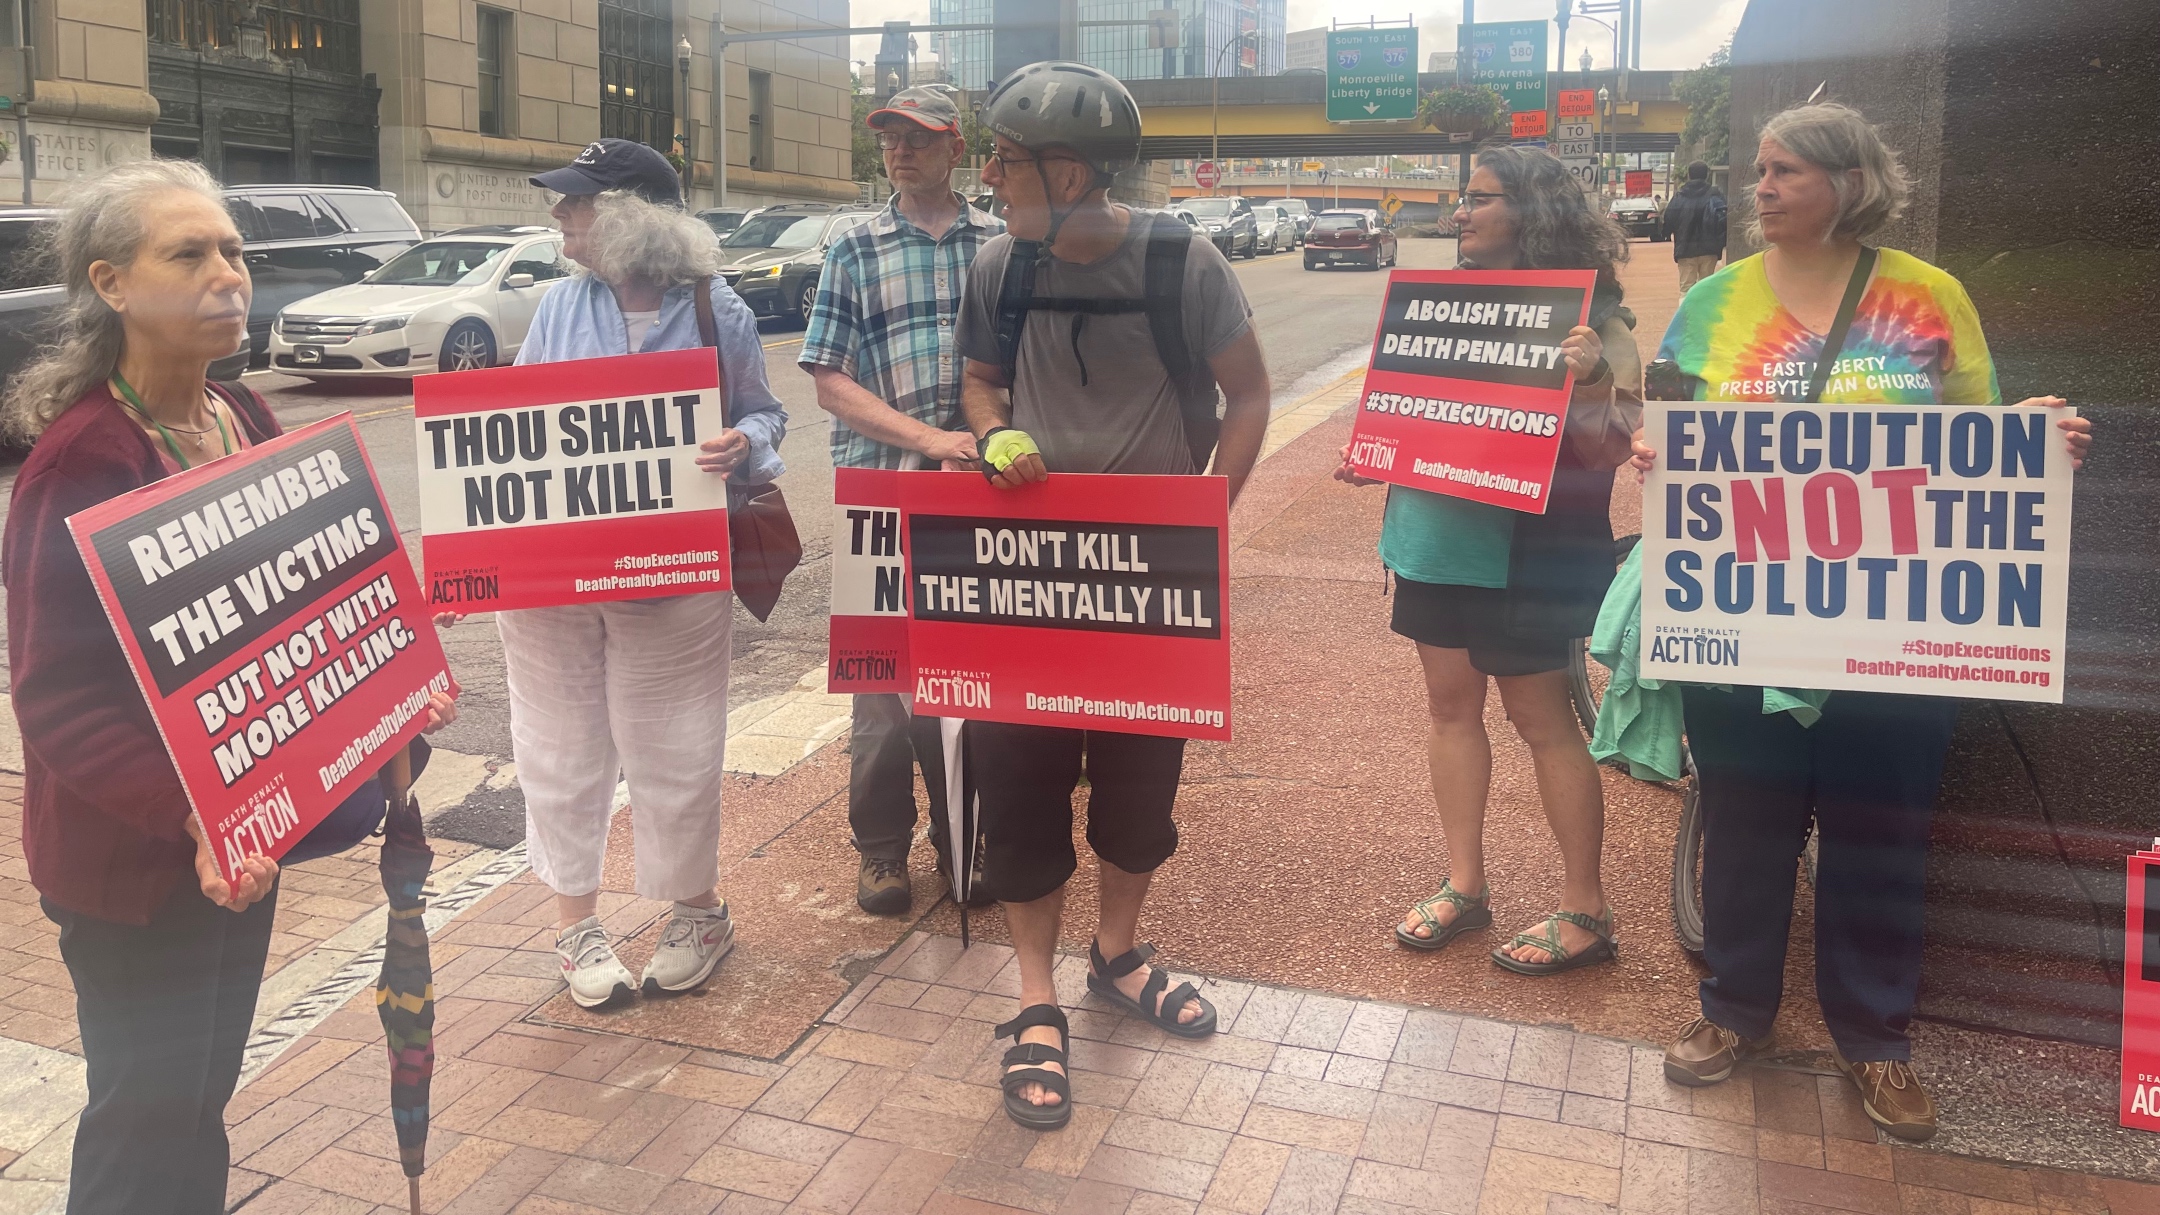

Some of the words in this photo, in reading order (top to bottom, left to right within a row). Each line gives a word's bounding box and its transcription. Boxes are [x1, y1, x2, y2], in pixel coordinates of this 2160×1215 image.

[1335, 37, 1362, 45] SOUTH
[1384, 34, 1407, 43] EAST
[1509, 27, 1534, 36] EAST
[1339, 54, 1358, 65] 579
[1385, 53, 1405, 63] 376
[1511, 46, 1533, 57] 380
[1339, 73, 1405, 85] Monroeville
[1498, 69, 1533, 78] Arena
[1515, 79, 1541, 90] Blvd
[1331, 88, 1370, 99] Liberty
[1376, 86, 1413, 98] Bridge
[1568, 94, 1584, 102] END
[1521, 115, 1537, 123] END
[1561, 104, 1592, 113] DETOUR
[1514, 125, 1545, 134] DETOUR
[1566, 126, 1584, 136] TO
[1563, 143, 1589, 155] EAST
[37, 155, 86, 171] FFICE
[460, 173, 499, 187] UNITED
[506, 177, 538, 190] STAT
[466, 189, 492, 202] POST
[500, 191, 533, 205] OFFICE
[1404, 299, 1501, 326] ABOLISH
[1503, 303, 1553, 329] THE
[1382, 333, 1453, 361] DEATH
[1453, 338, 1563, 370] PENALTY
[1762, 361, 1807, 377] EAST
[1813, 356, 1886, 376] BERTY
[1719, 375, 1858, 397] PRESBYTEIAN
[1866, 372, 1932, 390] CHURCH
[1365, 392, 1559, 437] #STOPEXECUTIONS
[424, 409, 547, 470] THOU
[558, 394, 701, 458] SHALT
[1357, 433, 1374, 442] DEATH
[1375, 436, 1400, 446] PENALTY
[1666, 410, 2047, 479] EXECUTION
[1349, 441, 1397, 471] ACTION
[1412, 457, 1542, 499] DeathPenaltyAction.org
[464, 469, 552, 526] NOT
[564, 458, 674, 518] KILL!
[128, 449, 350, 585] REMEMBER
[1665, 483, 1723, 543] IS
[1730, 468, 1928, 563] NOT
[1925, 489, 2046, 552] THE
[847, 509, 904, 557] TH
[614, 549, 719, 571] #StopExecutions
[974, 527, 1067, 570] DON'T
[1077, 531, 1149, 573] KILL
[149, 585, 244, 667] THE
[234, 507, 380, 616] VICTIMS
[431, 575, 499, 604] ACTION
[575, 568, 720, 593] DeathPenaltyAction.org
[1664, 549, 2043, 629] SOLUTION
[919, 573, 980, 614] THE
[989, 578, 1152, 624] MENTALLY
[1162, 588, 1212, 629] ILL
[1655, 625, 1689, 634] DEATH
[1693, 628, 1740, 636] PENALTY
[197, 661, 264, 734] BUT
[264, 618, 330, 688] NOT
[326, 573, 399, 642] WITH
[1650, 635, 1739, 667] ACTION
[1902, 639, 2051, 663] #StopExecutions
[834, 656, 897, 681] ACTION
[918, 667, 947, 676] DEATH
[951, 669, 991, 680] PENALTY
[1845, 657, 2050, 688] DeathPenaltyAction.org
[212, 691, 312, 787] MORE
[306, 618, 416, 715] KILLING.
[915, 676, 991, 709] ACTION
[1025, 692, 1224, 728] DeathPenaltyAction.org
[318, 669, 450, 792] DeathPenaltyActionorg
[218, 804, 248, 833] DEATH
[247, 772, 285, 808] PENALTY
[223, 786, 300, 882] ACTION
